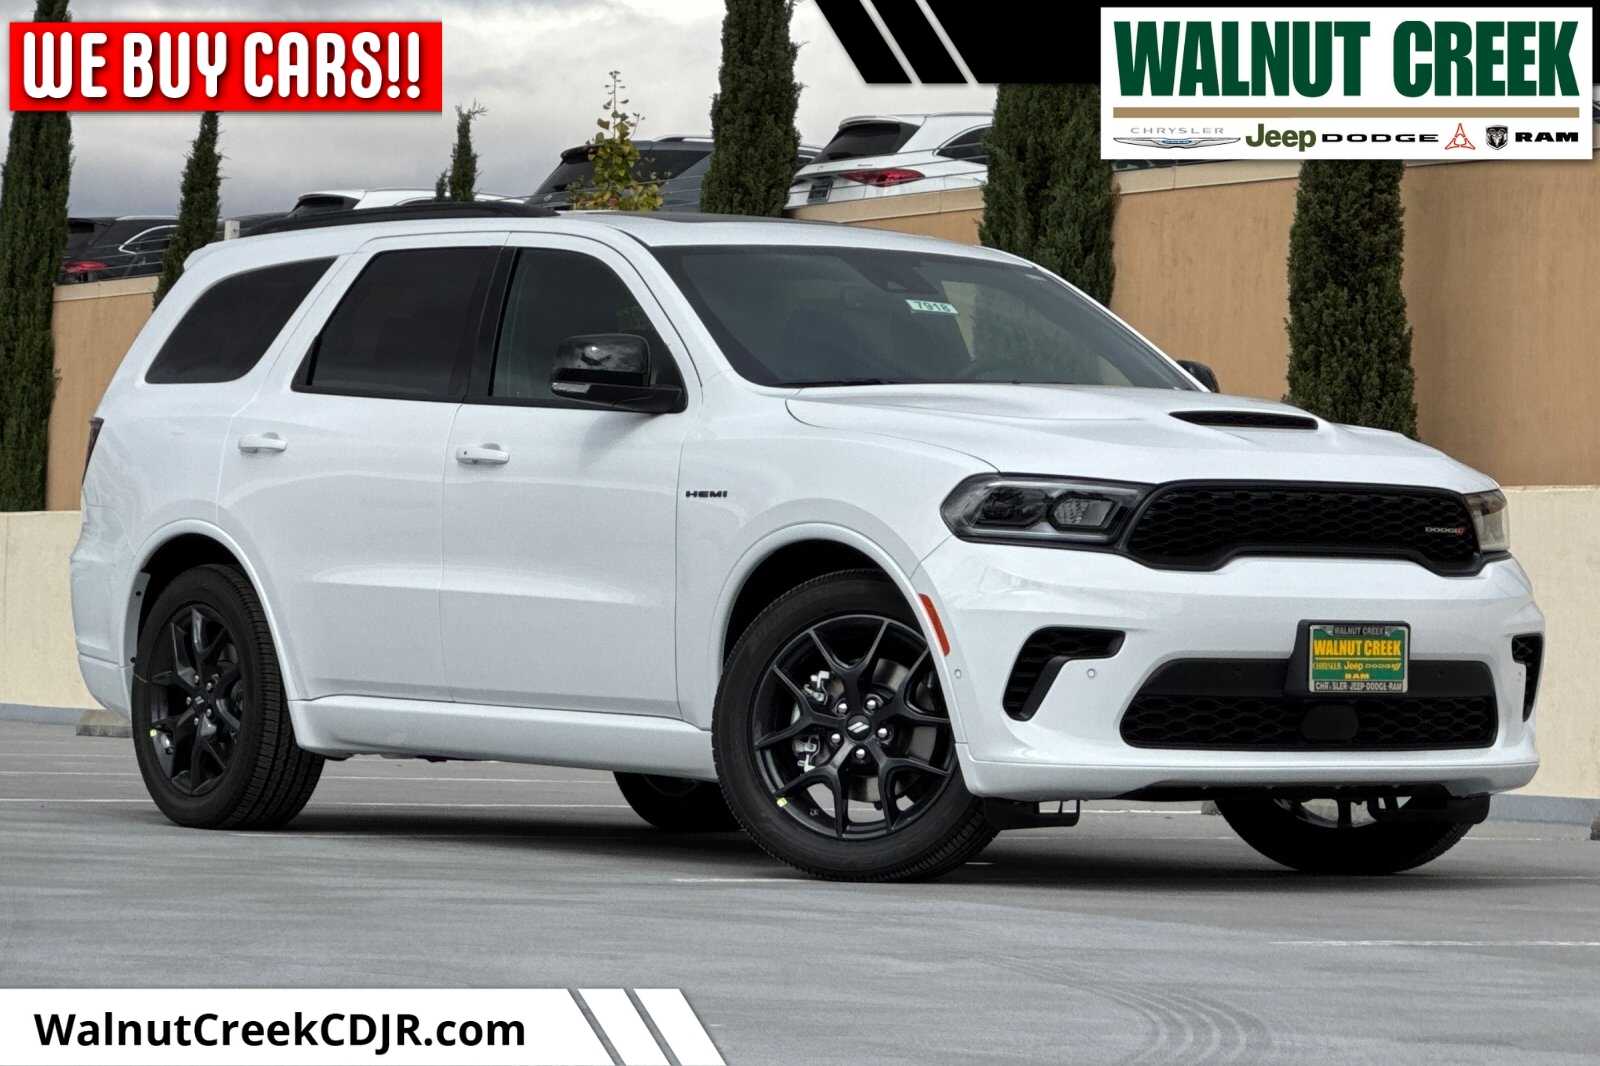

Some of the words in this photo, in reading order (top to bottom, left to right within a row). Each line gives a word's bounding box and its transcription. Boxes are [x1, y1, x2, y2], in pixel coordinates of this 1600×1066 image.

[685, 490, 728, 498] HEMI
[1313, 639, 1361, 656] WALNUT
[1364, 639, 1401, 656] CREEK
[1344, 660, 1364, 671] Jeep
